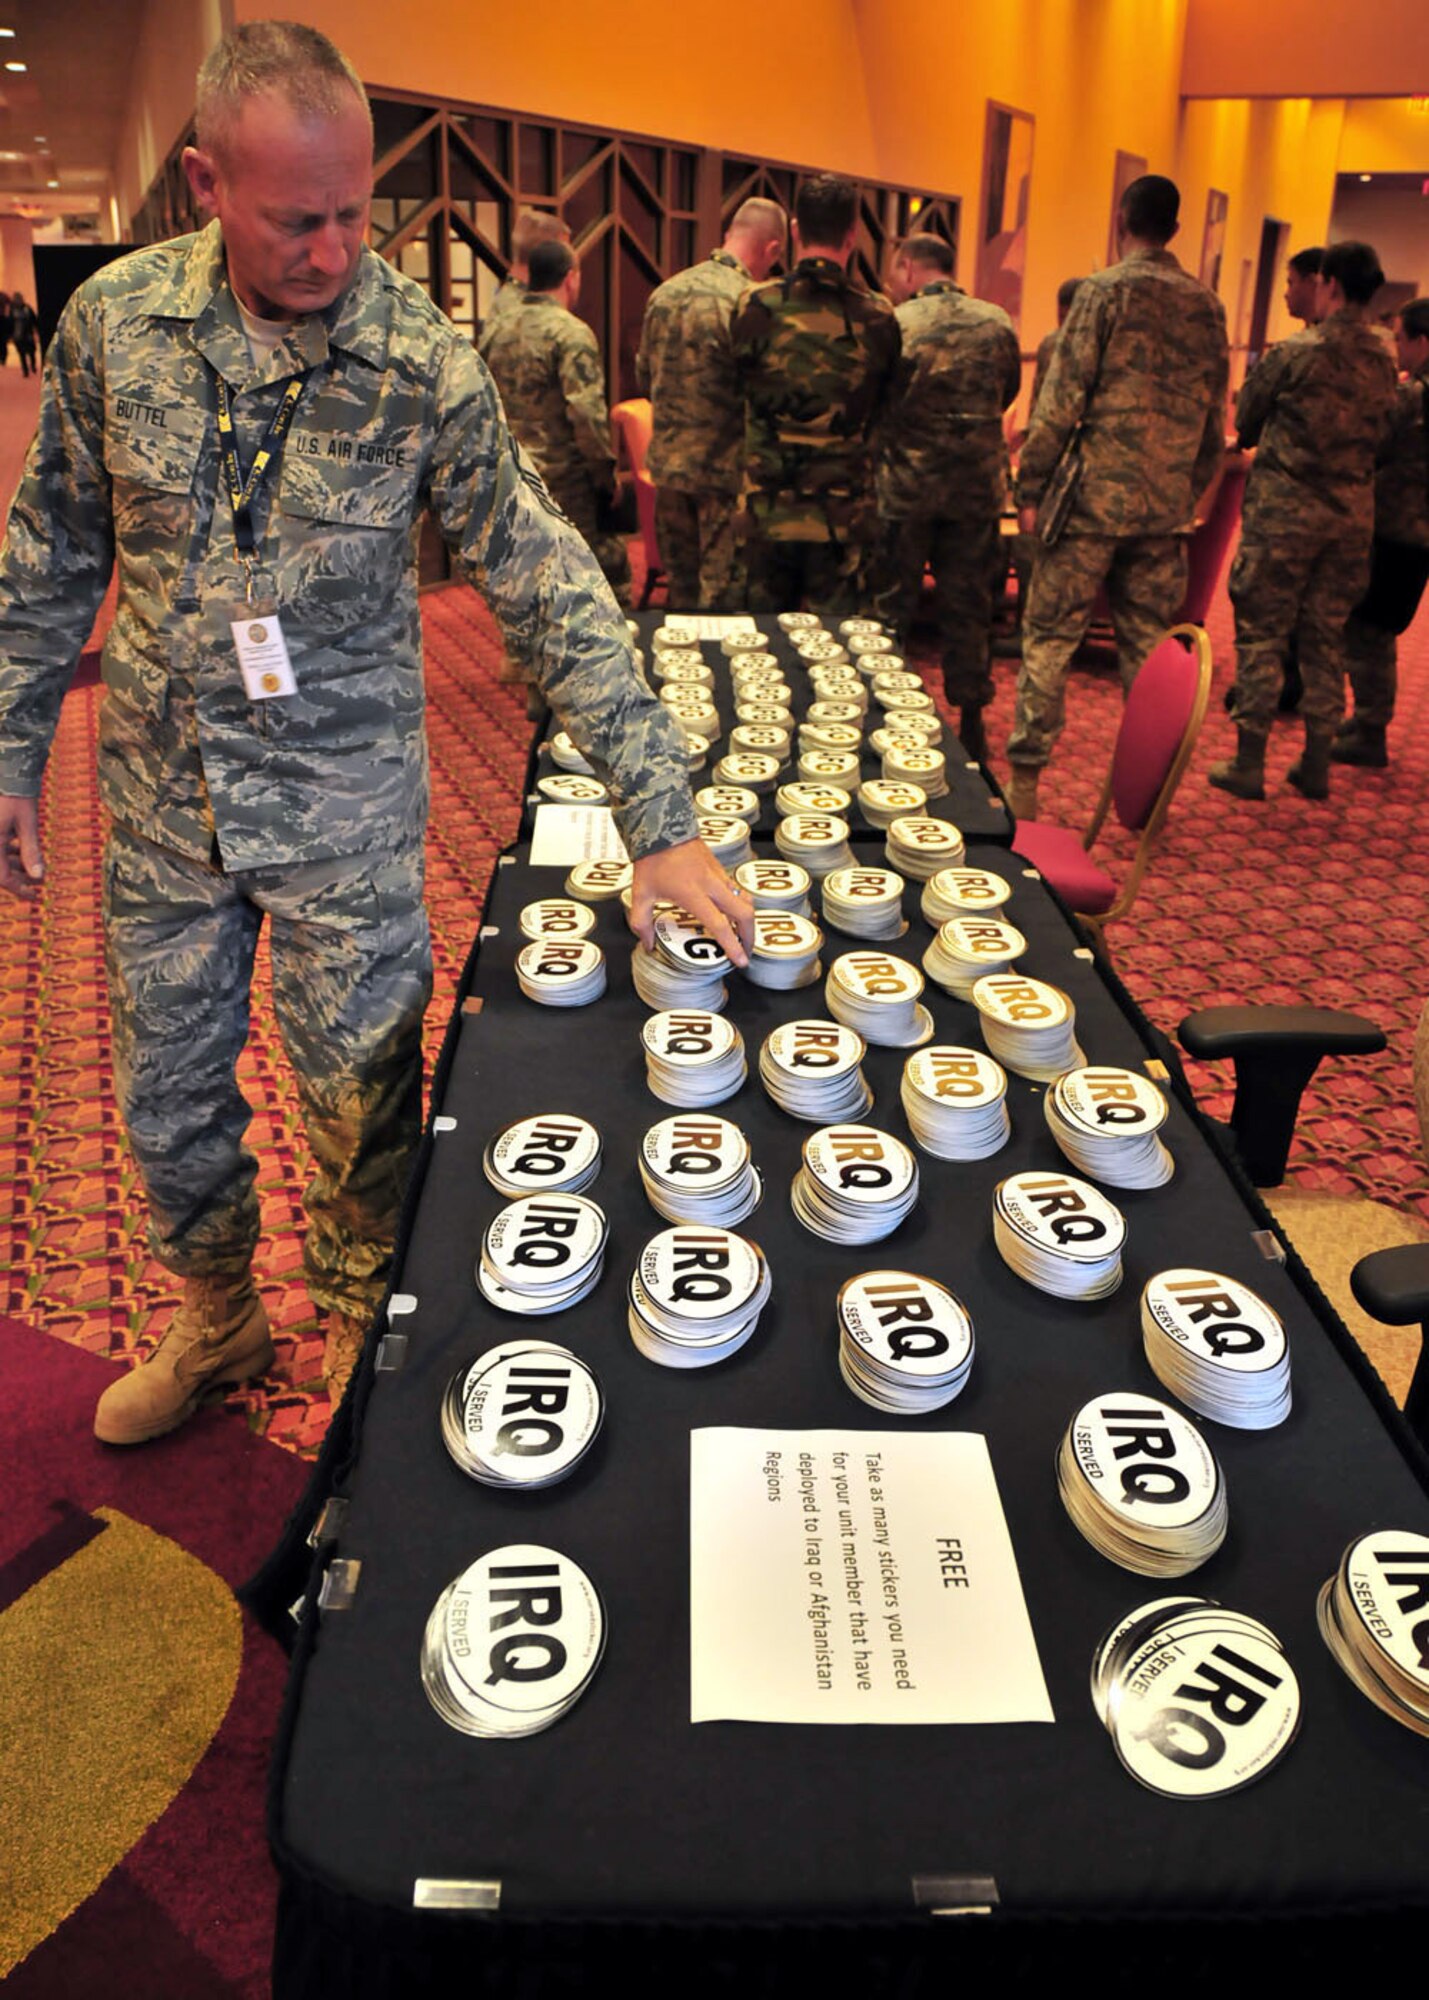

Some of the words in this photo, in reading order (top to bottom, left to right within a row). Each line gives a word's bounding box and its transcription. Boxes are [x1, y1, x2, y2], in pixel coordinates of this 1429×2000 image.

[115, 400, 168, 428] BUTTEL
[297, 436, 322, 455] U.S.
[327, 439, 353, 459] AIR
[357, 443, 405, 468] FORCE
[738, 755, 767, 775] AFG
[816, 752, 845, 772] AFG
[714, 787, 744, 812] AFG
[798, 784, 843, 811] AFG
[878, 782, 917, 806] AFG
[800, 817, 833, 841] IRQ
[903, 821, 949, 845] IRQ
[582, 861, 629, 887] IRQ
[754, 864, 793, 891] IRQ
[849, 870, 886, 898] IRQ
[951, 872, 997, 899] IRQ
[540, 904, 579, 933] IRQ
[754, 914, 803, 946] IRQ
[960, 922, 1010, 955] IRQ
[533, 942, 585, 976] IRQ
[849, 957, 908, 996] IRQ
[987, 980, 1052, 1021] IRQ
[664, 1015, 713, 1055] IRQ
[789, 1026, 840, 1068] IRQ
[930, 1053, 984, 1097] IRQ
[1083, 1074, 1147, 1125] IRQ
[507, 1122, 583, 1176] IRQ
[665, 1122, 723, 1175] IRQ
[828, 1133, 893, 1189] IRQ
[1006, 1201, 1038, 1233] SERVED
[1018, 1179, 1107, 1245] IRQ
[490, 1217, 513, 1250] SERVED
[507, 1204, 581, 1268] IRQ
[643, 1251, 659, 1285] SERVED
[668, 1235, 732, 1303] IRQ
[844, 1307, 873, 1344] SERVED
[863, 1283, 950, 1361] IRQ
[1154, 1304, 1189, 1342] SERVED
[1164, 1279, 1265, 1357] IRQ
[468, 1389, 488, 1433] SERVED
[496, 1367, 571, 1457] IRQ
[832, 1451, 850, 1471] for
[864, 1452, 882, 1483] Take
[1076, 1430, 1104, 1480] SERVED
[1100, 1408, 1191, 1505] IRQ
[762, 1450, 782, 1503] Regions
[798, 1452, 822, 1514] deployed
[831, 1475, 850, 1505] your
[870, 1488, 882, 1502] as
[804, 1517, 820, 1534] to
[838, 1510, 856, 1538] unit
[872, 1506, 891, 1546] many
[804, 1537, 824, 1567] Iraq
[936, 1538, 970, 1589] FREE
[808, 1571, 824, 1589] or
[842, 1542, 866, 1606] member
[877, 1550, 900, 1608] stickers
[483, 1564, 568, 1687] IRQ
[849, 1611, 869, 1646] that
[883, 1614, 904, 1643] you
[1354, 1580, 1394, 1639] SERVED
[1373, 1552, 1429, 1670] IR
[451, 1600, 471, 1658] SERVED
[807, 1593, 833, 1691] Afghanistan
[854, 1649, 874, 1692] have
[891, 1648, 917, 1691] need
[1131, 1643, 1284, 1771] IRQ
